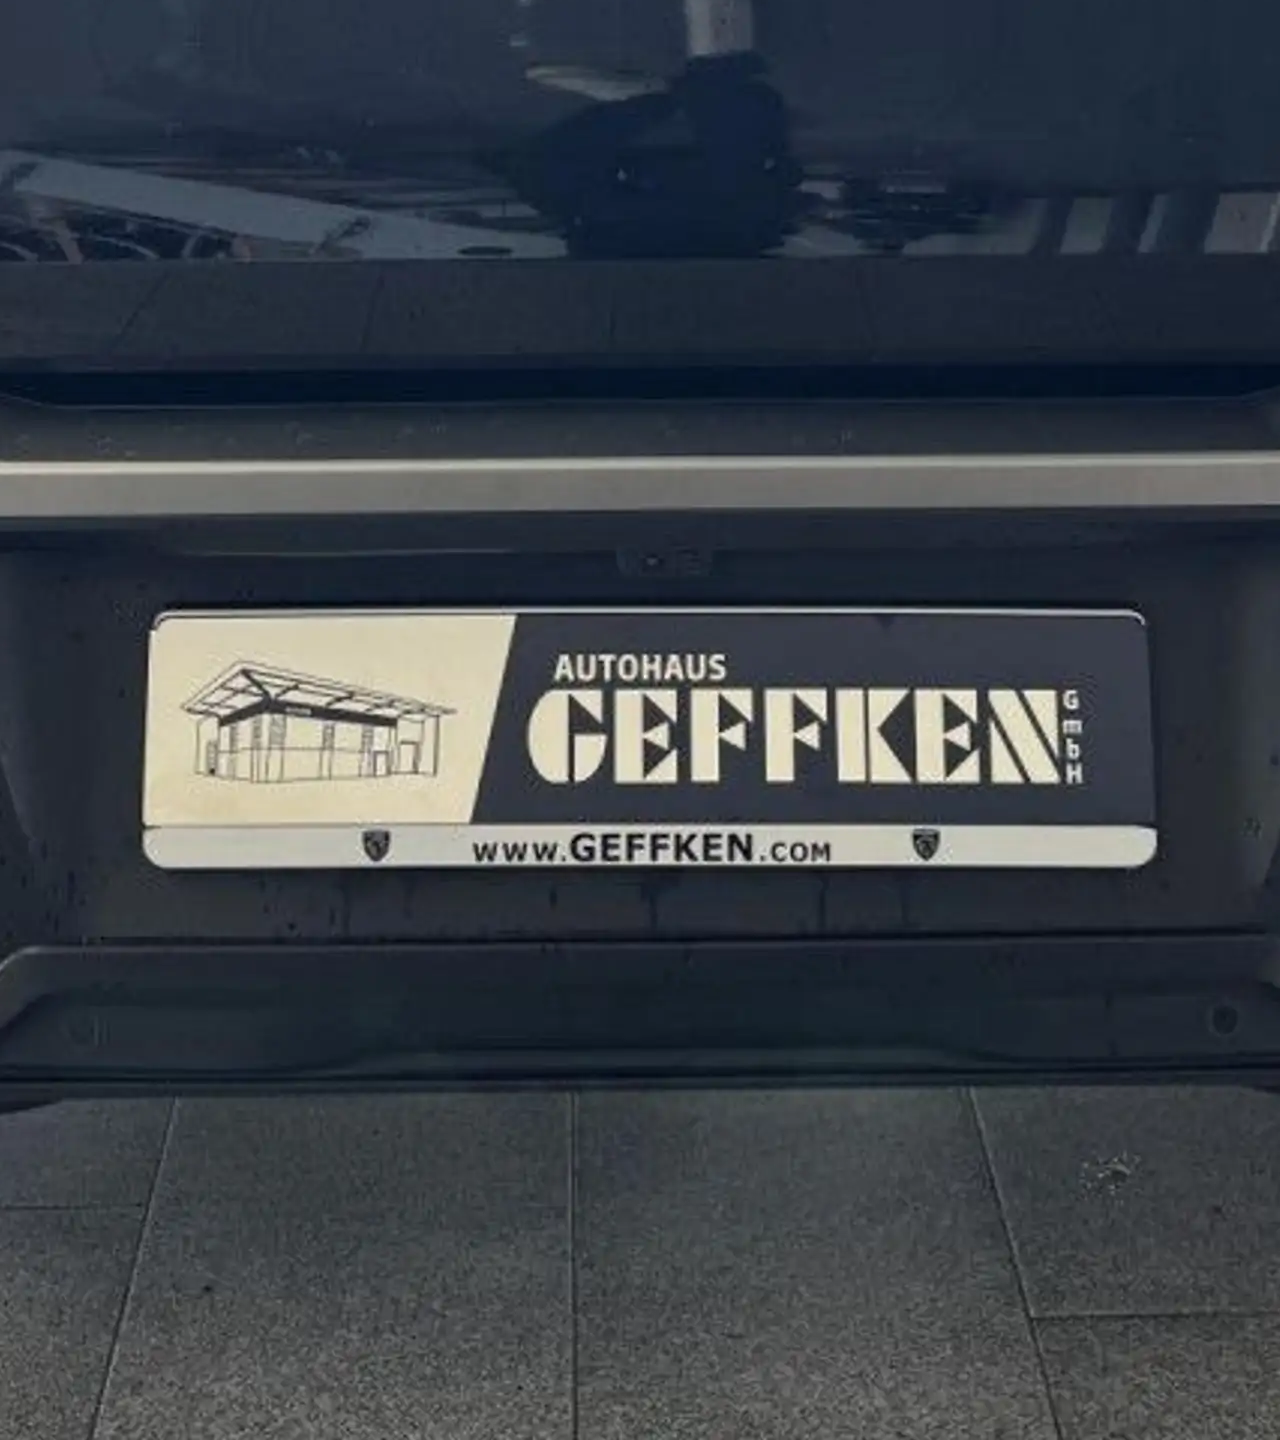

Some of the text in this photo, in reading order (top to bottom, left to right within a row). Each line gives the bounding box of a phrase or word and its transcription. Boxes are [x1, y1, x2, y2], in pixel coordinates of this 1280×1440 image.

[554, 653, 727, 681] AUTOHAUS
[527, 688, 1061, 785] GEFFKEN
[1062, 690, 1083, 785] GmbH
